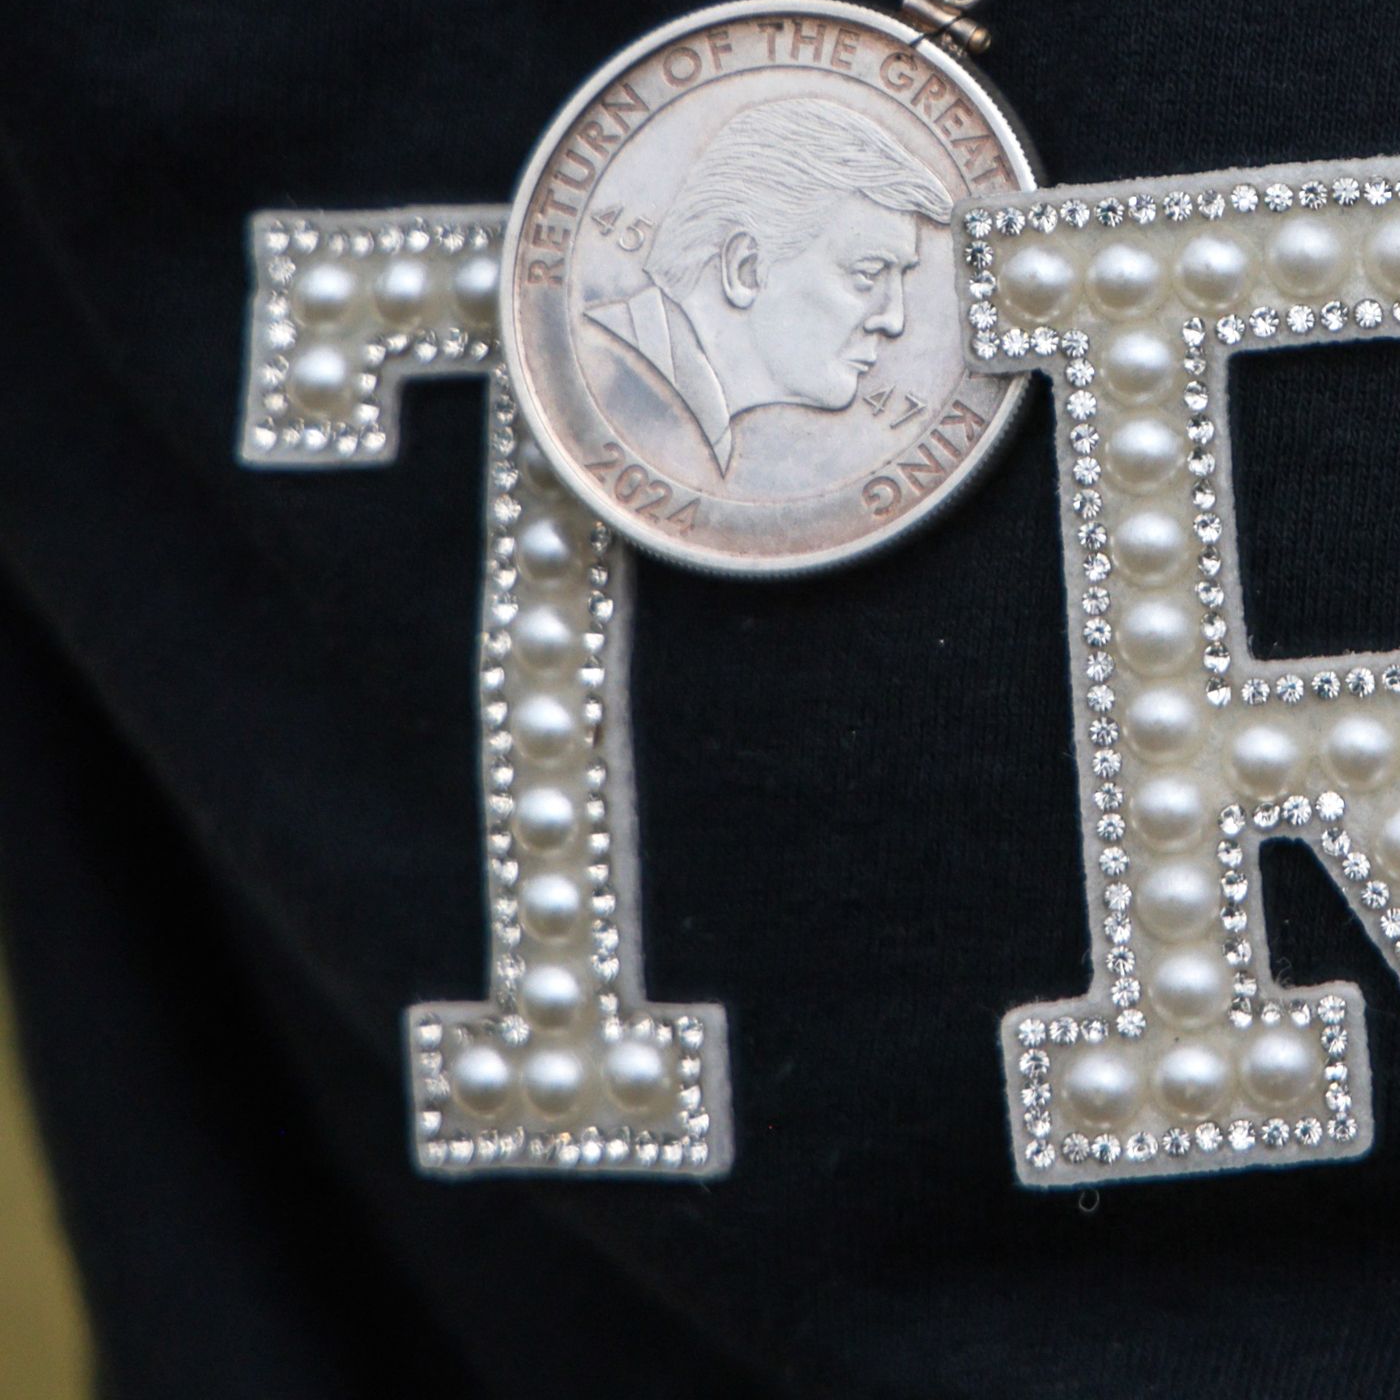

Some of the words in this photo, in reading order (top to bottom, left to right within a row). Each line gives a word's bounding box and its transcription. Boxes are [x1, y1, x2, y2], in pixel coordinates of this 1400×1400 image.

[661, 27, 733, 89] OF
[756, 18, 861, 69] THE
[878, 51, 1011, 186] GREAT
[526, 81, 651, 286] RETURN
[590, 203, 654, 253] 45
[861, 382, 929, 430] 47
[583, 441, 702, 535] 2024
[861, 399, 987, 519] KING
